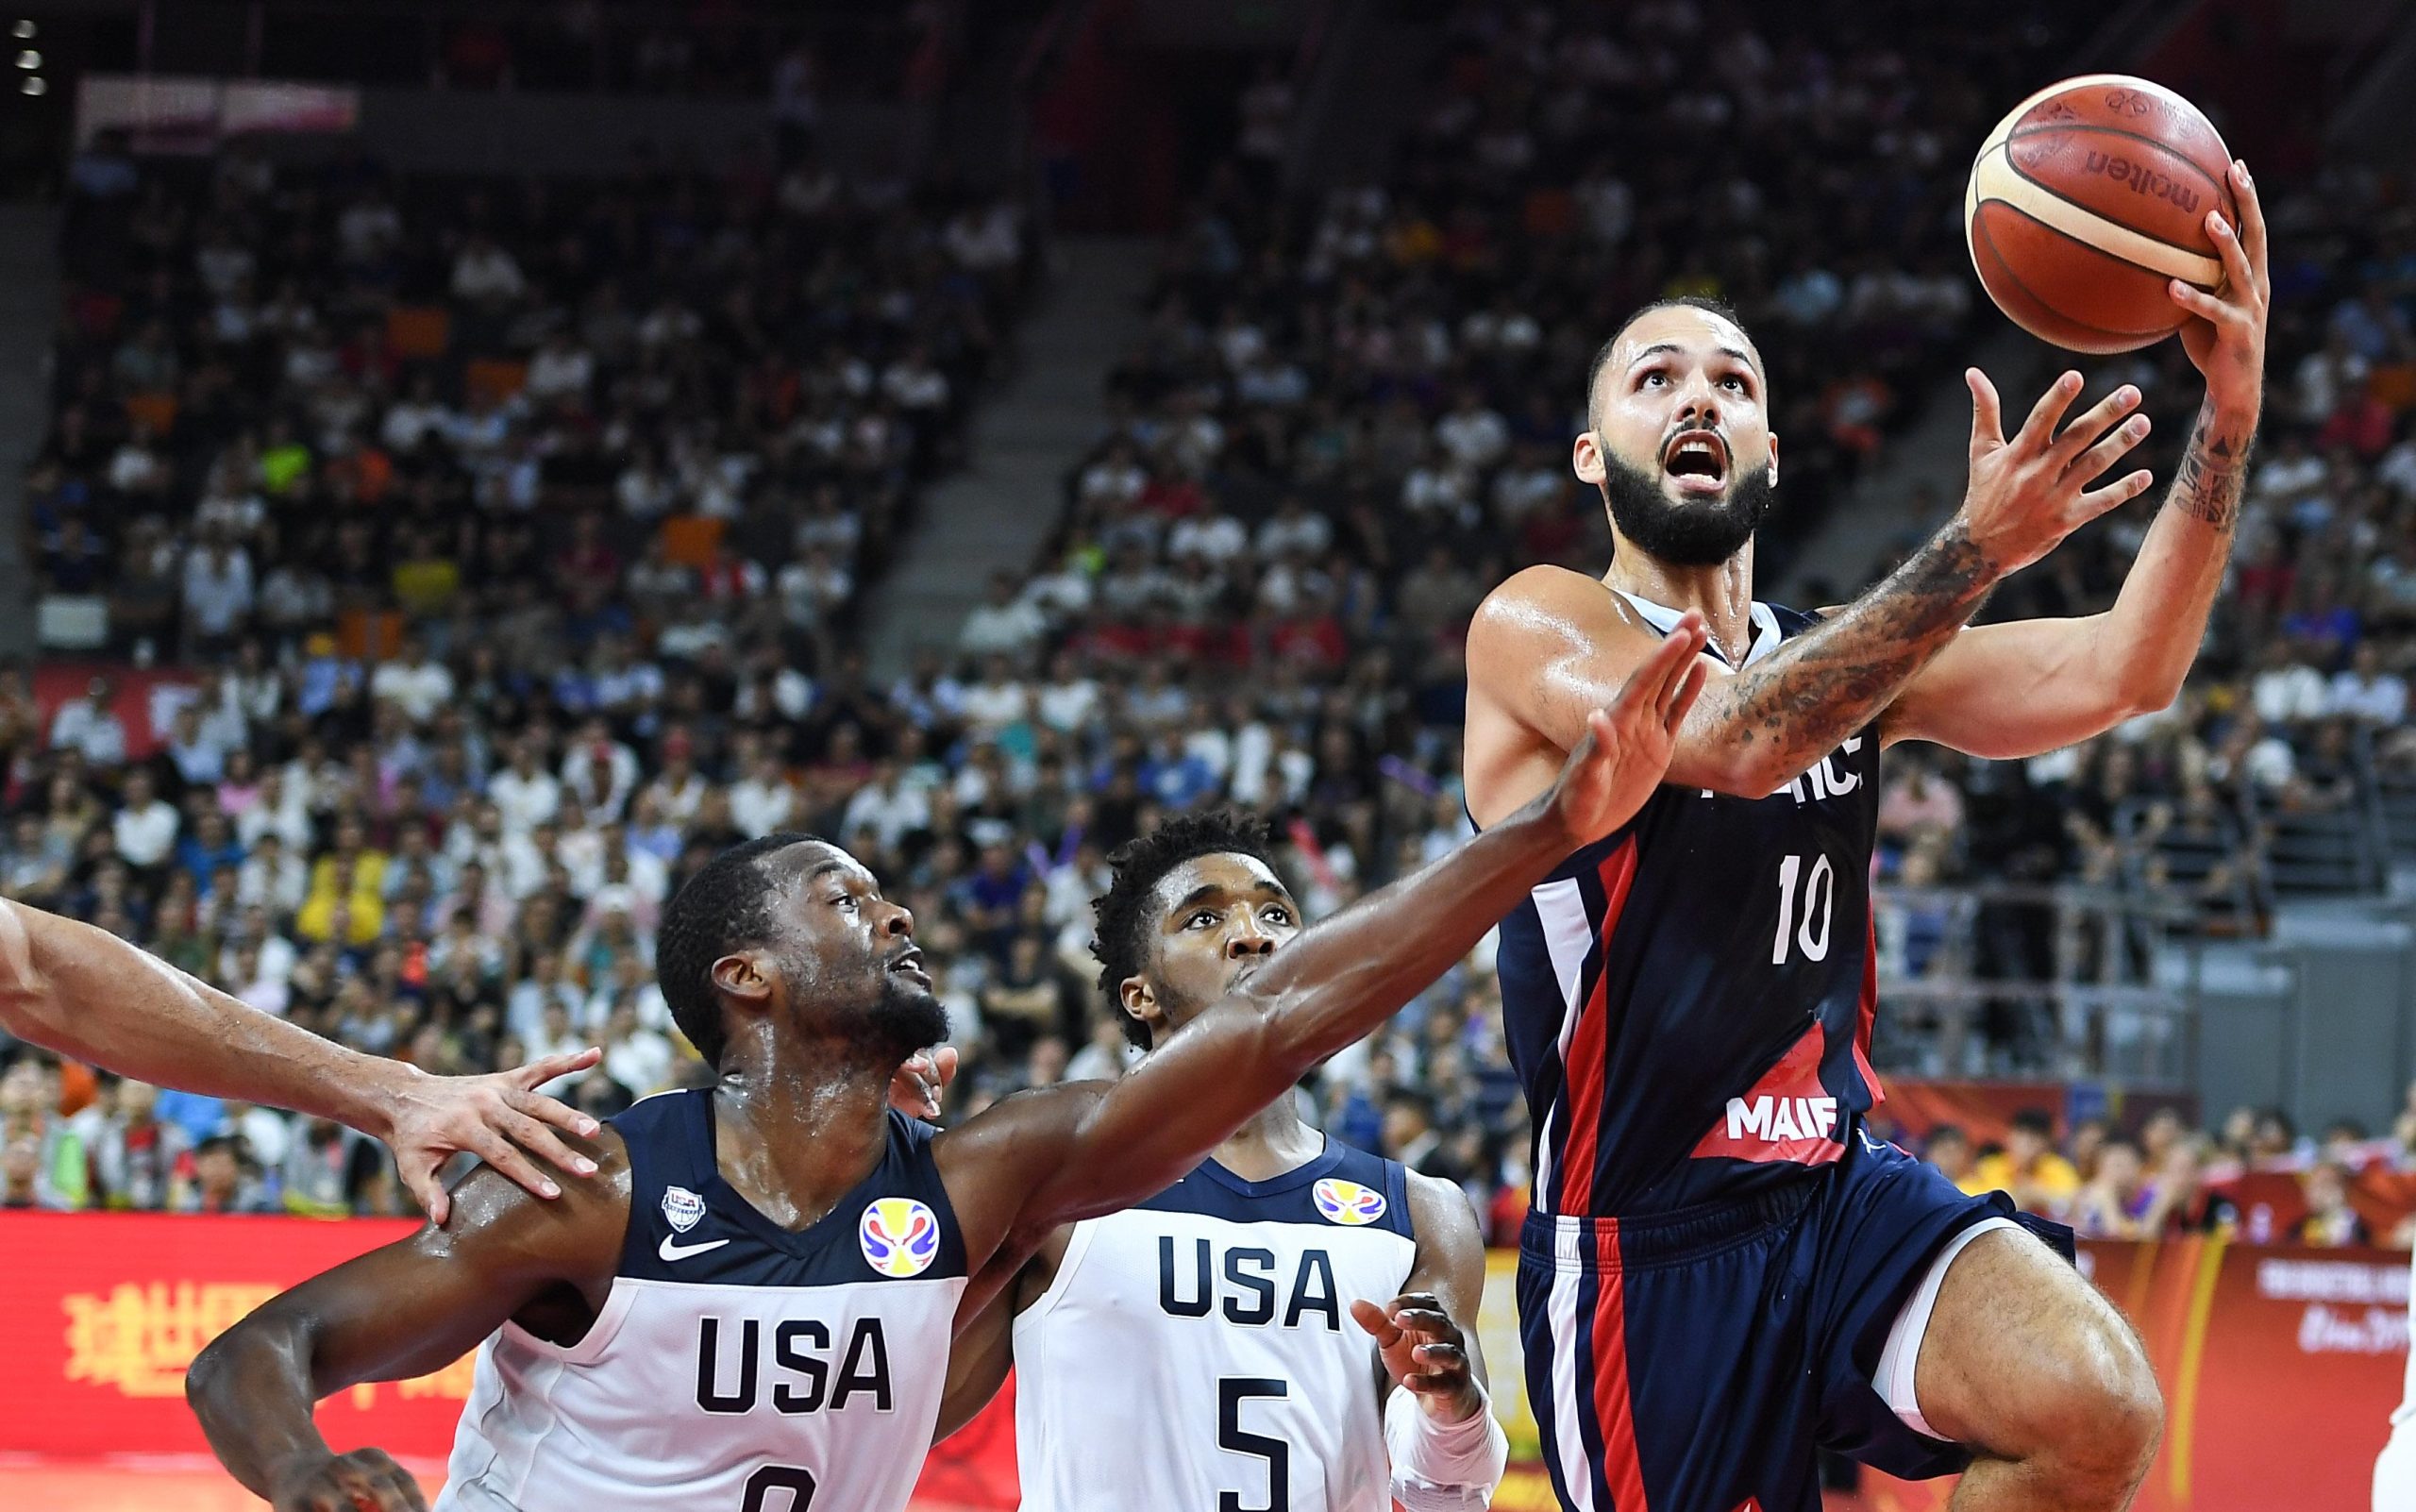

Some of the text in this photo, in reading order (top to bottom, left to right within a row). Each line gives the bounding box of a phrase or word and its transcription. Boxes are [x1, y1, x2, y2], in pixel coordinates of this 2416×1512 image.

[2086, 150, 2200, 213] molten
[1772, 853, 1834, 964] 10
[1726, 1095, 1837, 1142] MAIF
[1158, 1235, 1342, 1333] USA
[696, 1317, 894, 1415] USA
[1217, 1376, 1290, 1512] 5
